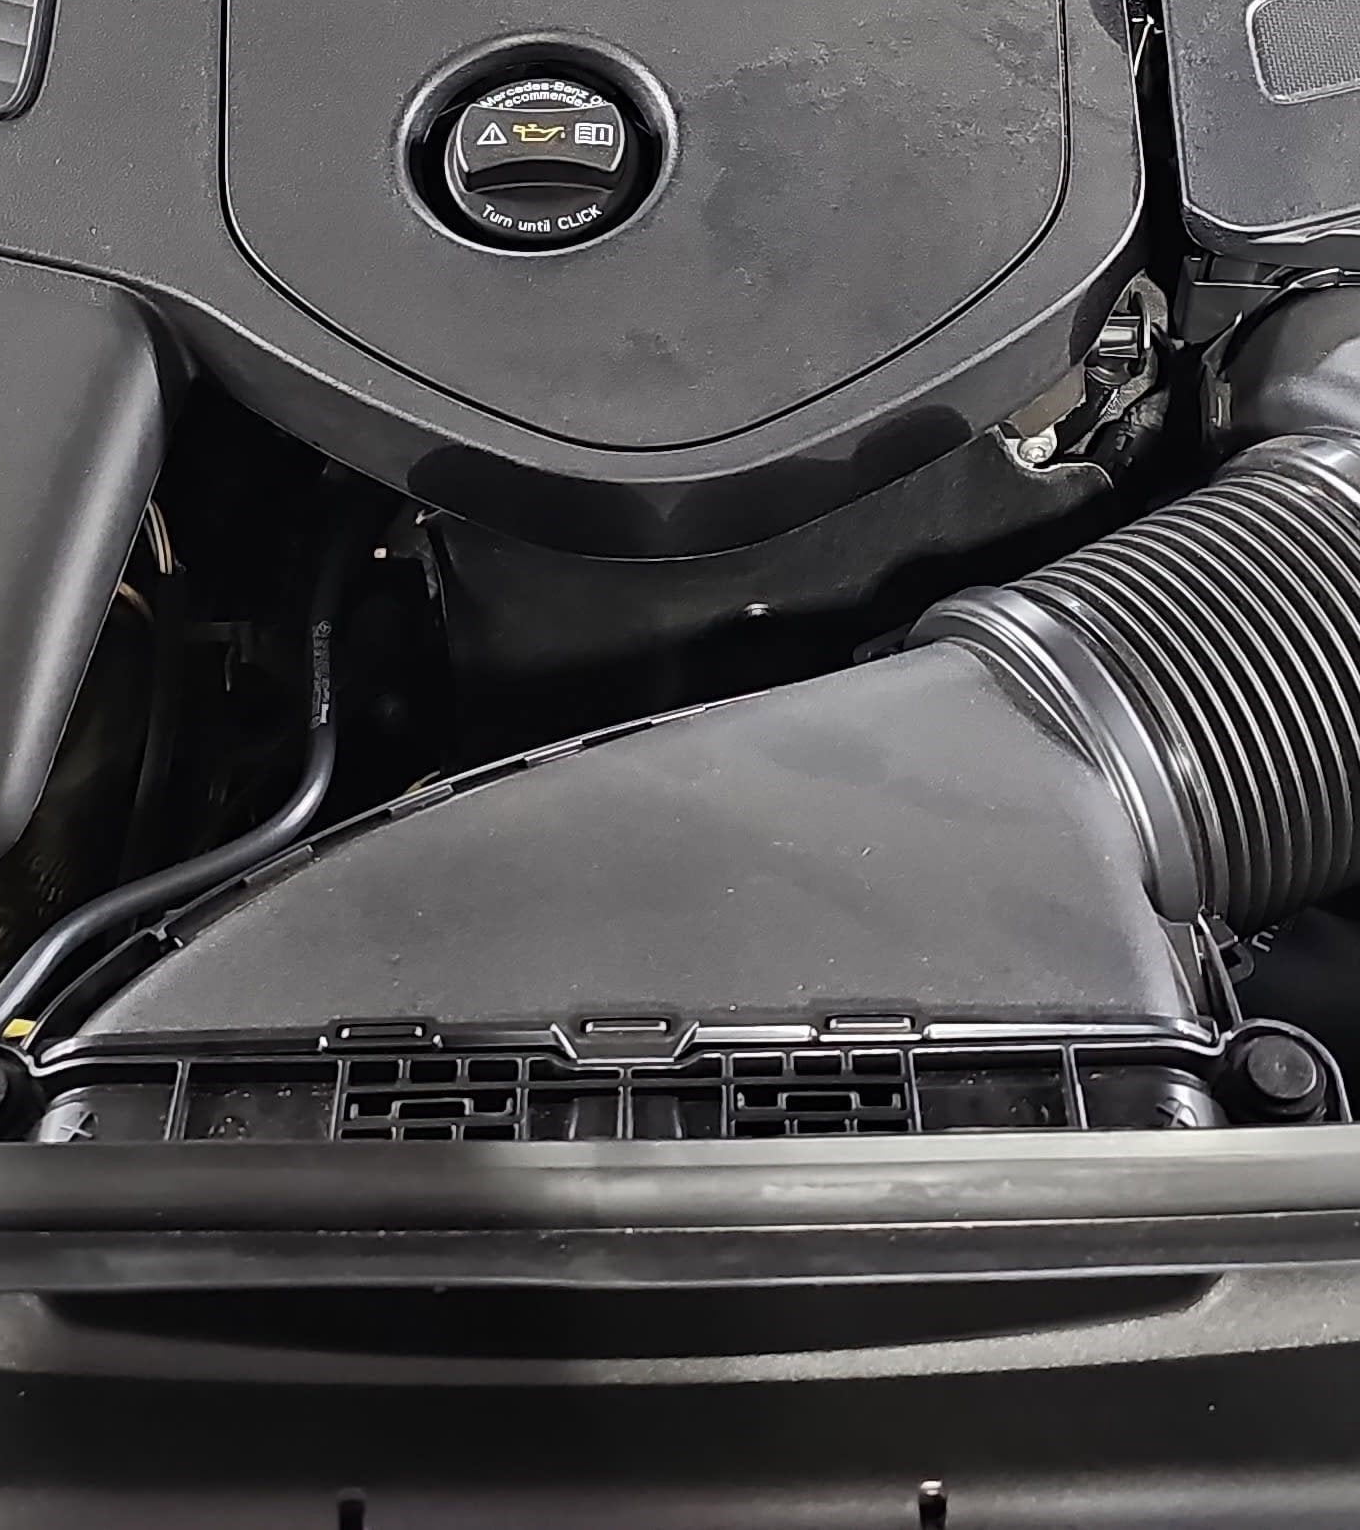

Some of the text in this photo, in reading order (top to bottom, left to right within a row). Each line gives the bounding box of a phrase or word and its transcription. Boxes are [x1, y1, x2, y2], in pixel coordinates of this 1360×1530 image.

[480, 81, 589, 108] Mercedes-Benz
[481, 203, 603, 233] Turn until CLICK
